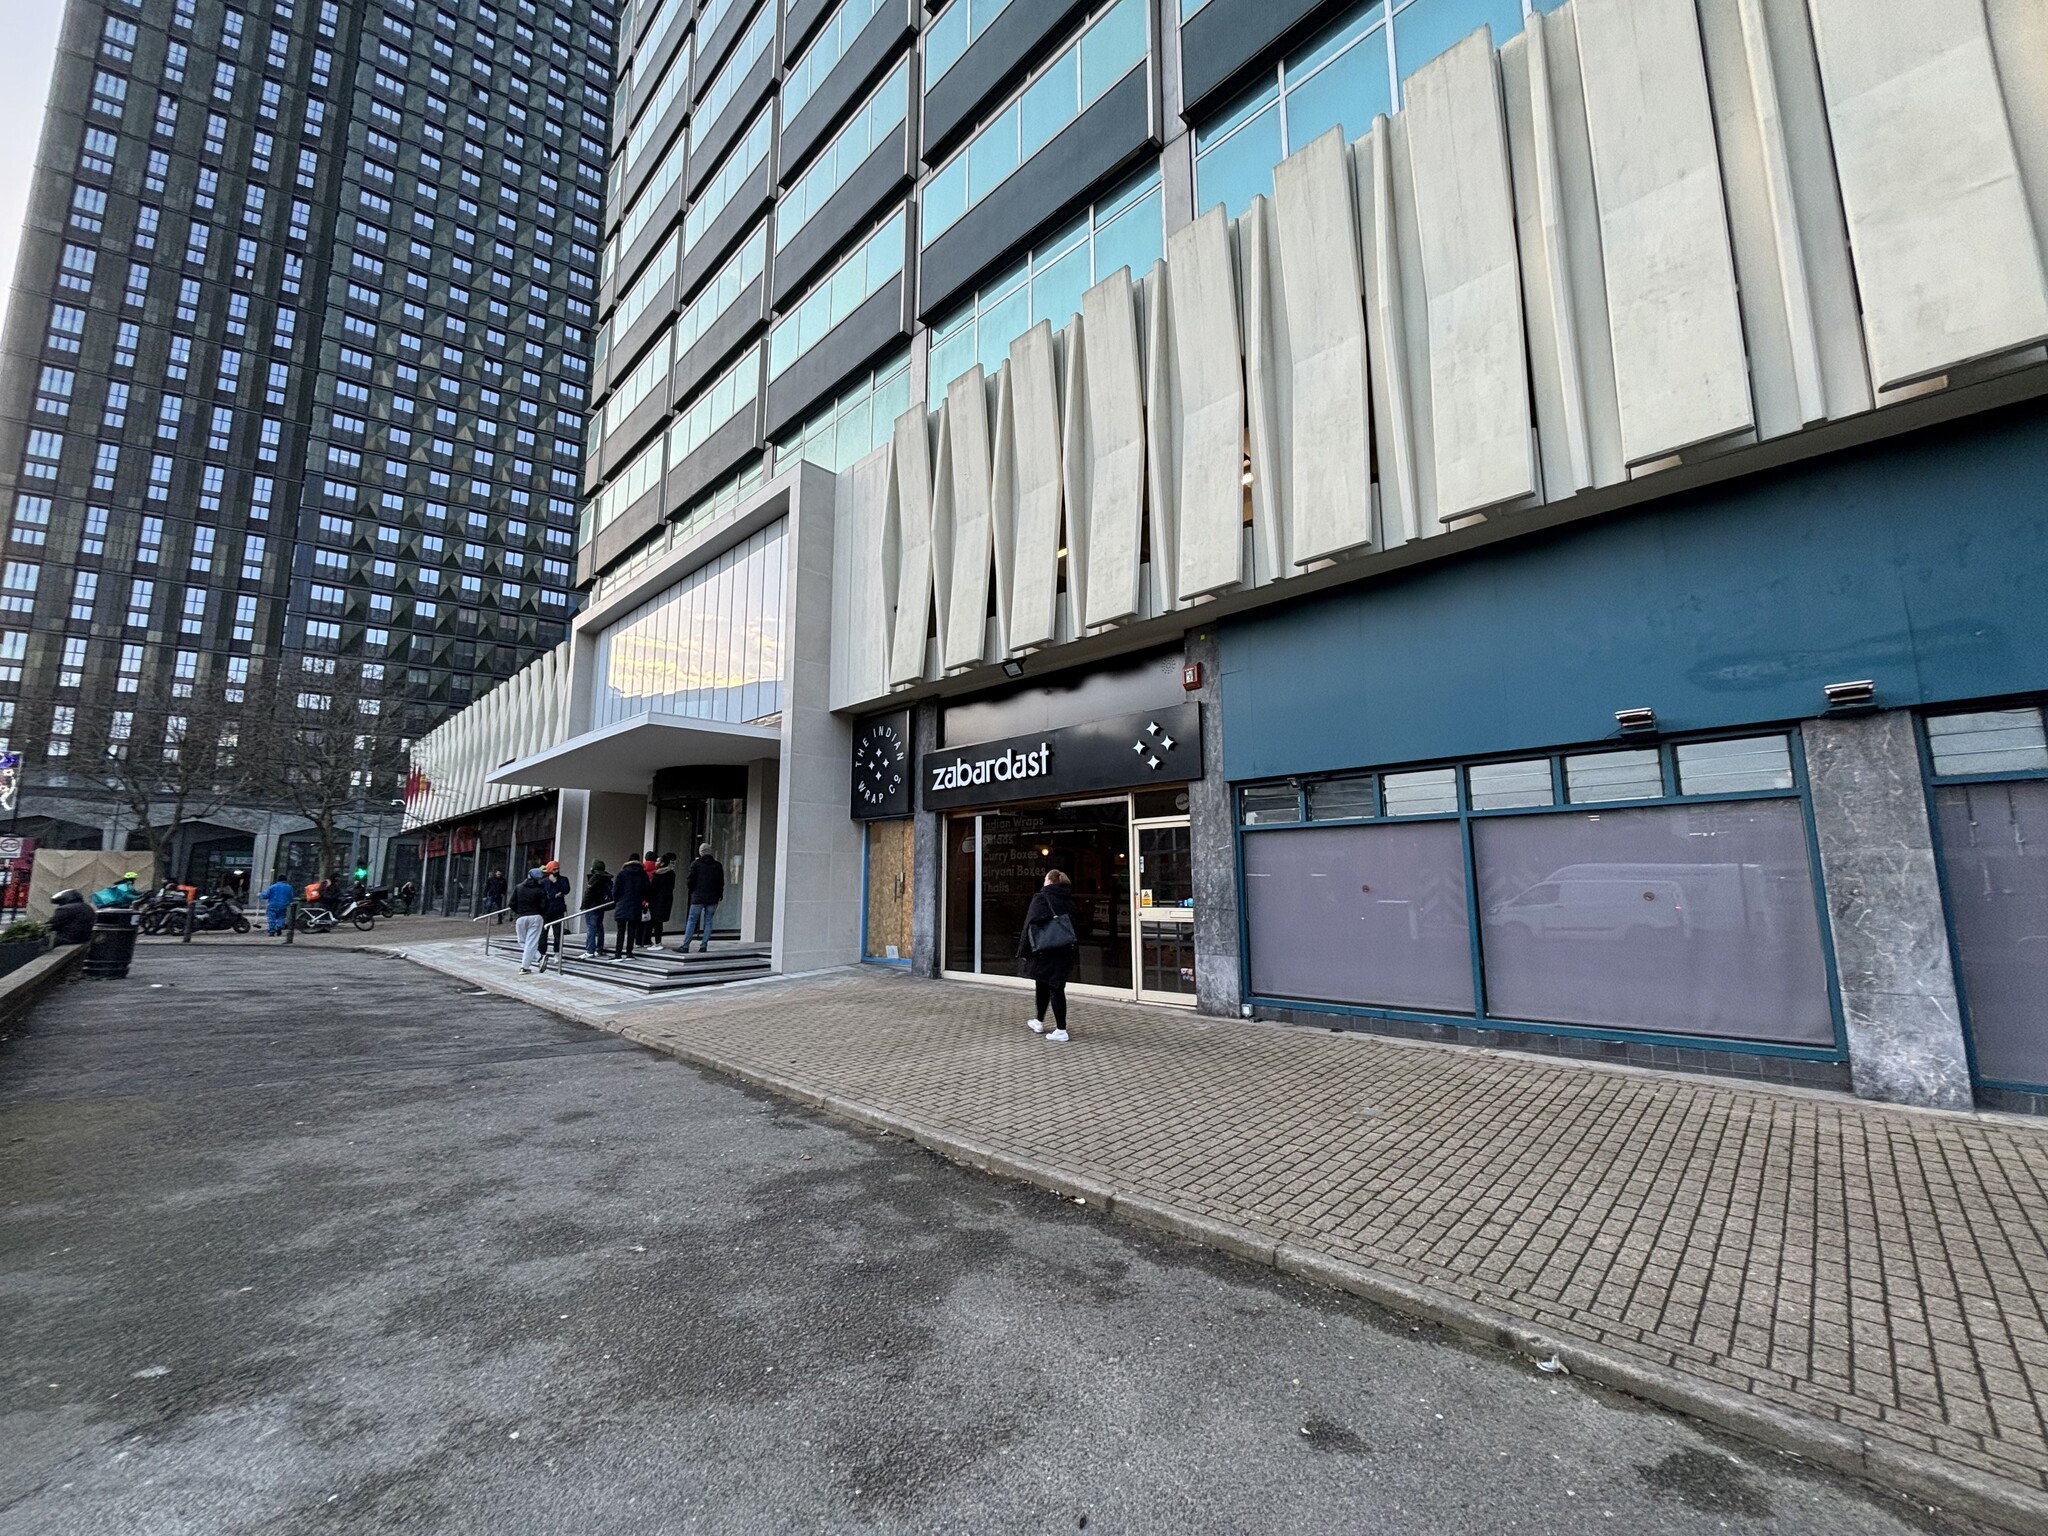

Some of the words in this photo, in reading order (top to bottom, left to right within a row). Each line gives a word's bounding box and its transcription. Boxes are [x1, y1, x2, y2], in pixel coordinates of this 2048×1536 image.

[855, 737, 869, 768] THE
[873, 725, 904, 761] INDIAN
[931, 742, 1049, 791] zabardast
[858, 780, 884, 804] WRAP
[1013, 816, 1044, 829] Wraps
[1010, 849, 1038, 859] Boxes
[1016, 865, 1046, 877] Boxes
